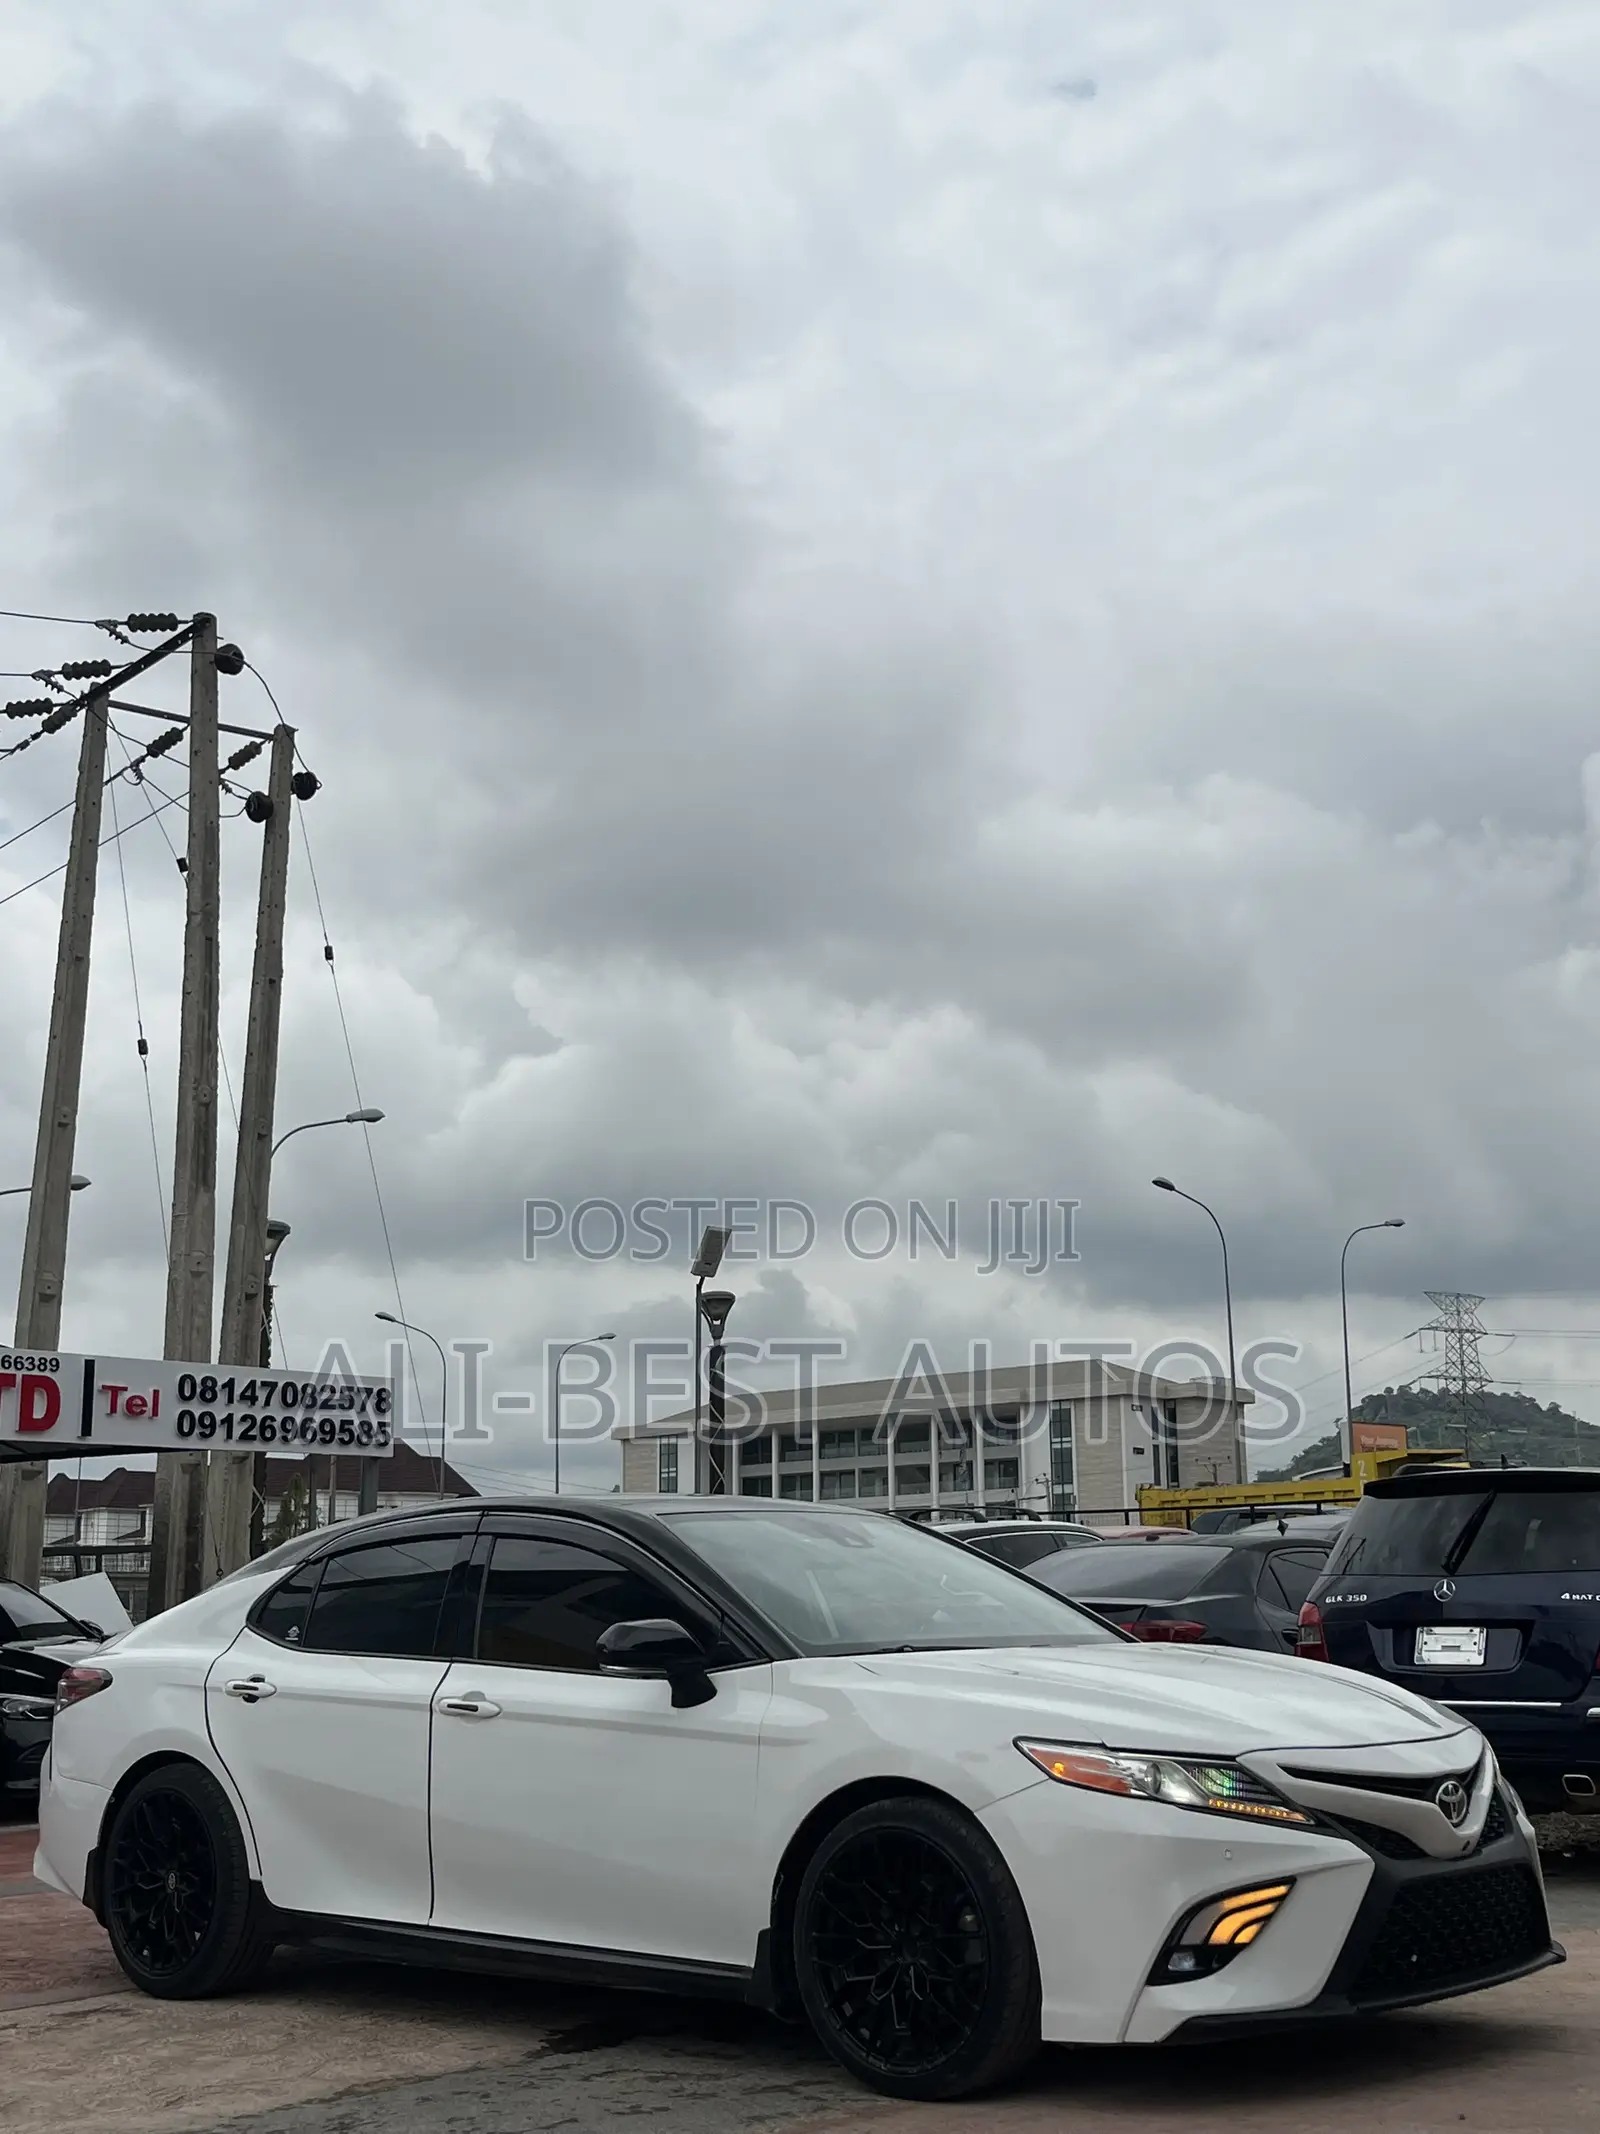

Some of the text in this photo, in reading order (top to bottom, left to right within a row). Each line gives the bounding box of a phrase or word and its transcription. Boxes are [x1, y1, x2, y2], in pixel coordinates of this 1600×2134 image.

[101, 1384, 160, 1418] Tel
[177, 1374, 392, 1414] 08147082578
[176, 1410, 391, 1447] 09126969585
[1325, 1594, 1367, 1603] GLK 350
